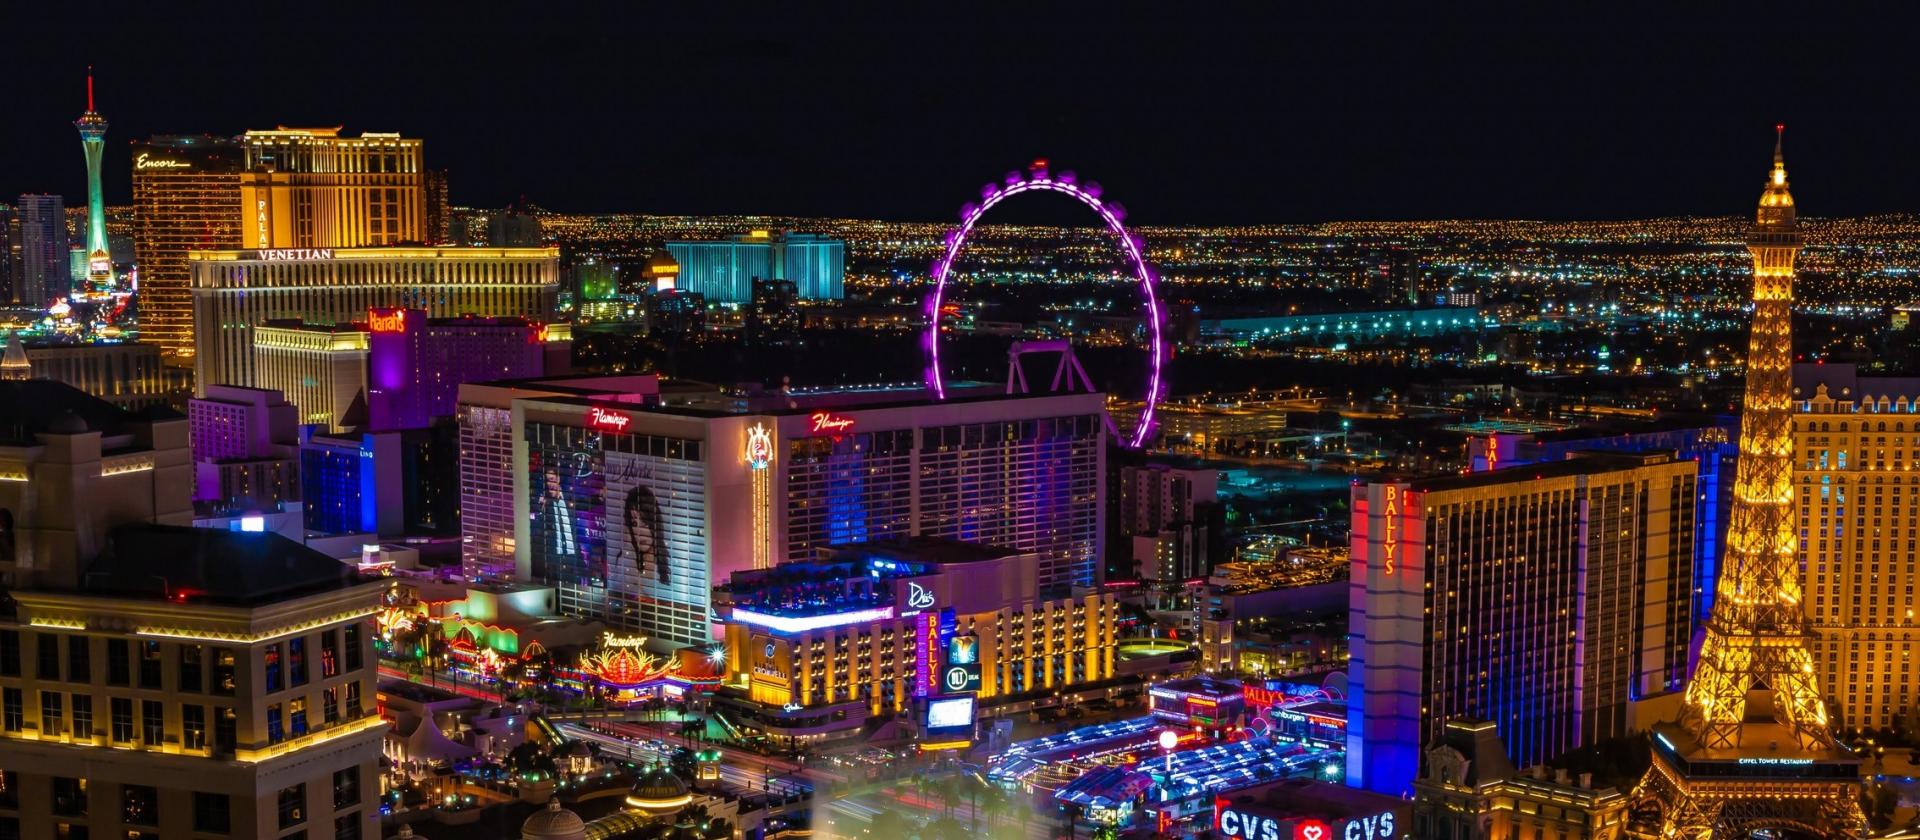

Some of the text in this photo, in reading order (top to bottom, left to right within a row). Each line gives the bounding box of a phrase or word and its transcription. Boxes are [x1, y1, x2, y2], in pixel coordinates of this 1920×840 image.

[137, 153, 191, 169] Encore
[258, 200, 268, 249] PALA
[258, 249, 332, 260] VENETIAN
[592, 408, 629, 430] Flamingo
[812, 413, 854, 432] Flamingo
[602, 631, 648, 650] Flamingo
[1220, 810, 1279, 840] CVS
[1344, 811, 1394, 840] CVS
